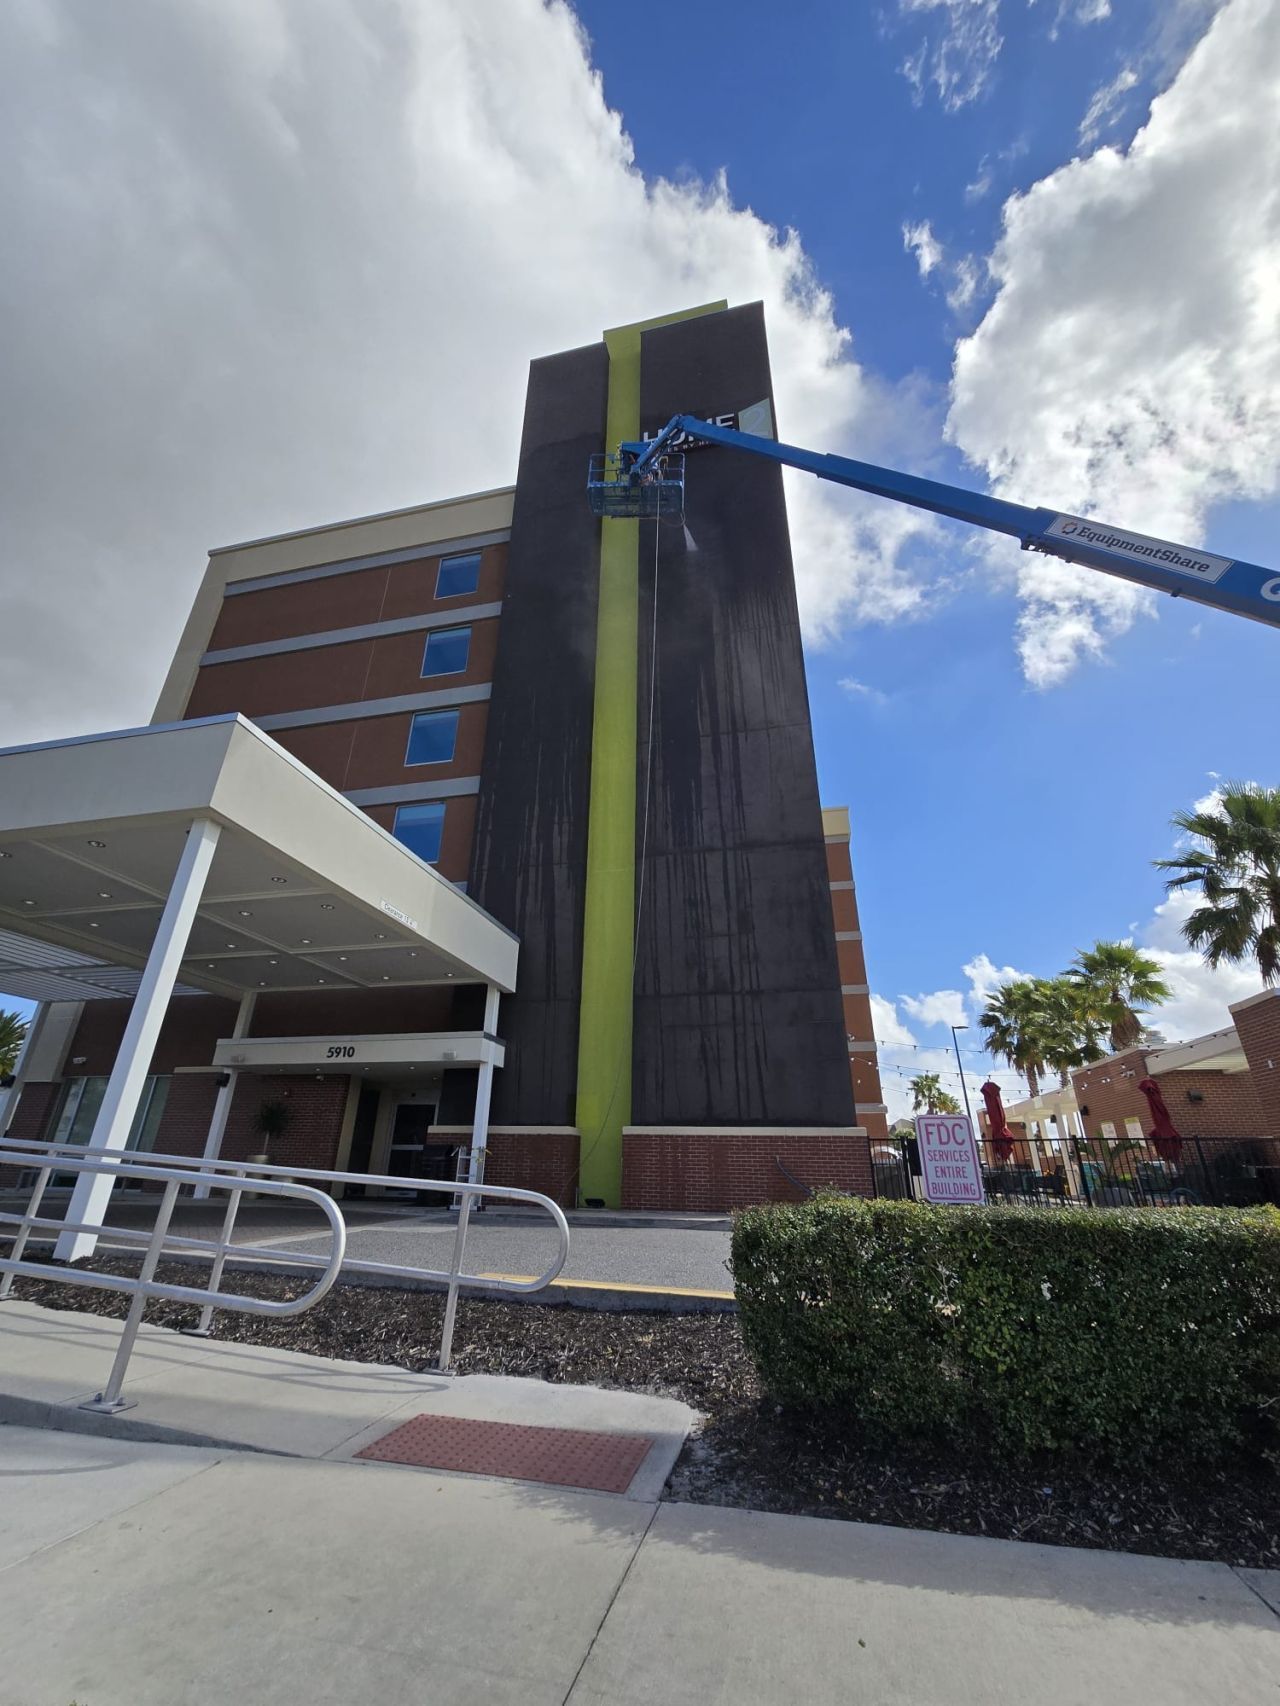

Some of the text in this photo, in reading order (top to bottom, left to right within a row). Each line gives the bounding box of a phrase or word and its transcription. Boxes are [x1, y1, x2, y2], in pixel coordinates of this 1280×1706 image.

[1076, 526, 1210, 573] EquipmentShare
[326, 1046, 355, 1058] 5910
[924, 1122, 966, 1146] FDC
[927, 1149, 971, 1162] SERVICES
[934, 1165, 969, 1179] ENTIRE
[931, 1181, 976, 1196] BUILDING
